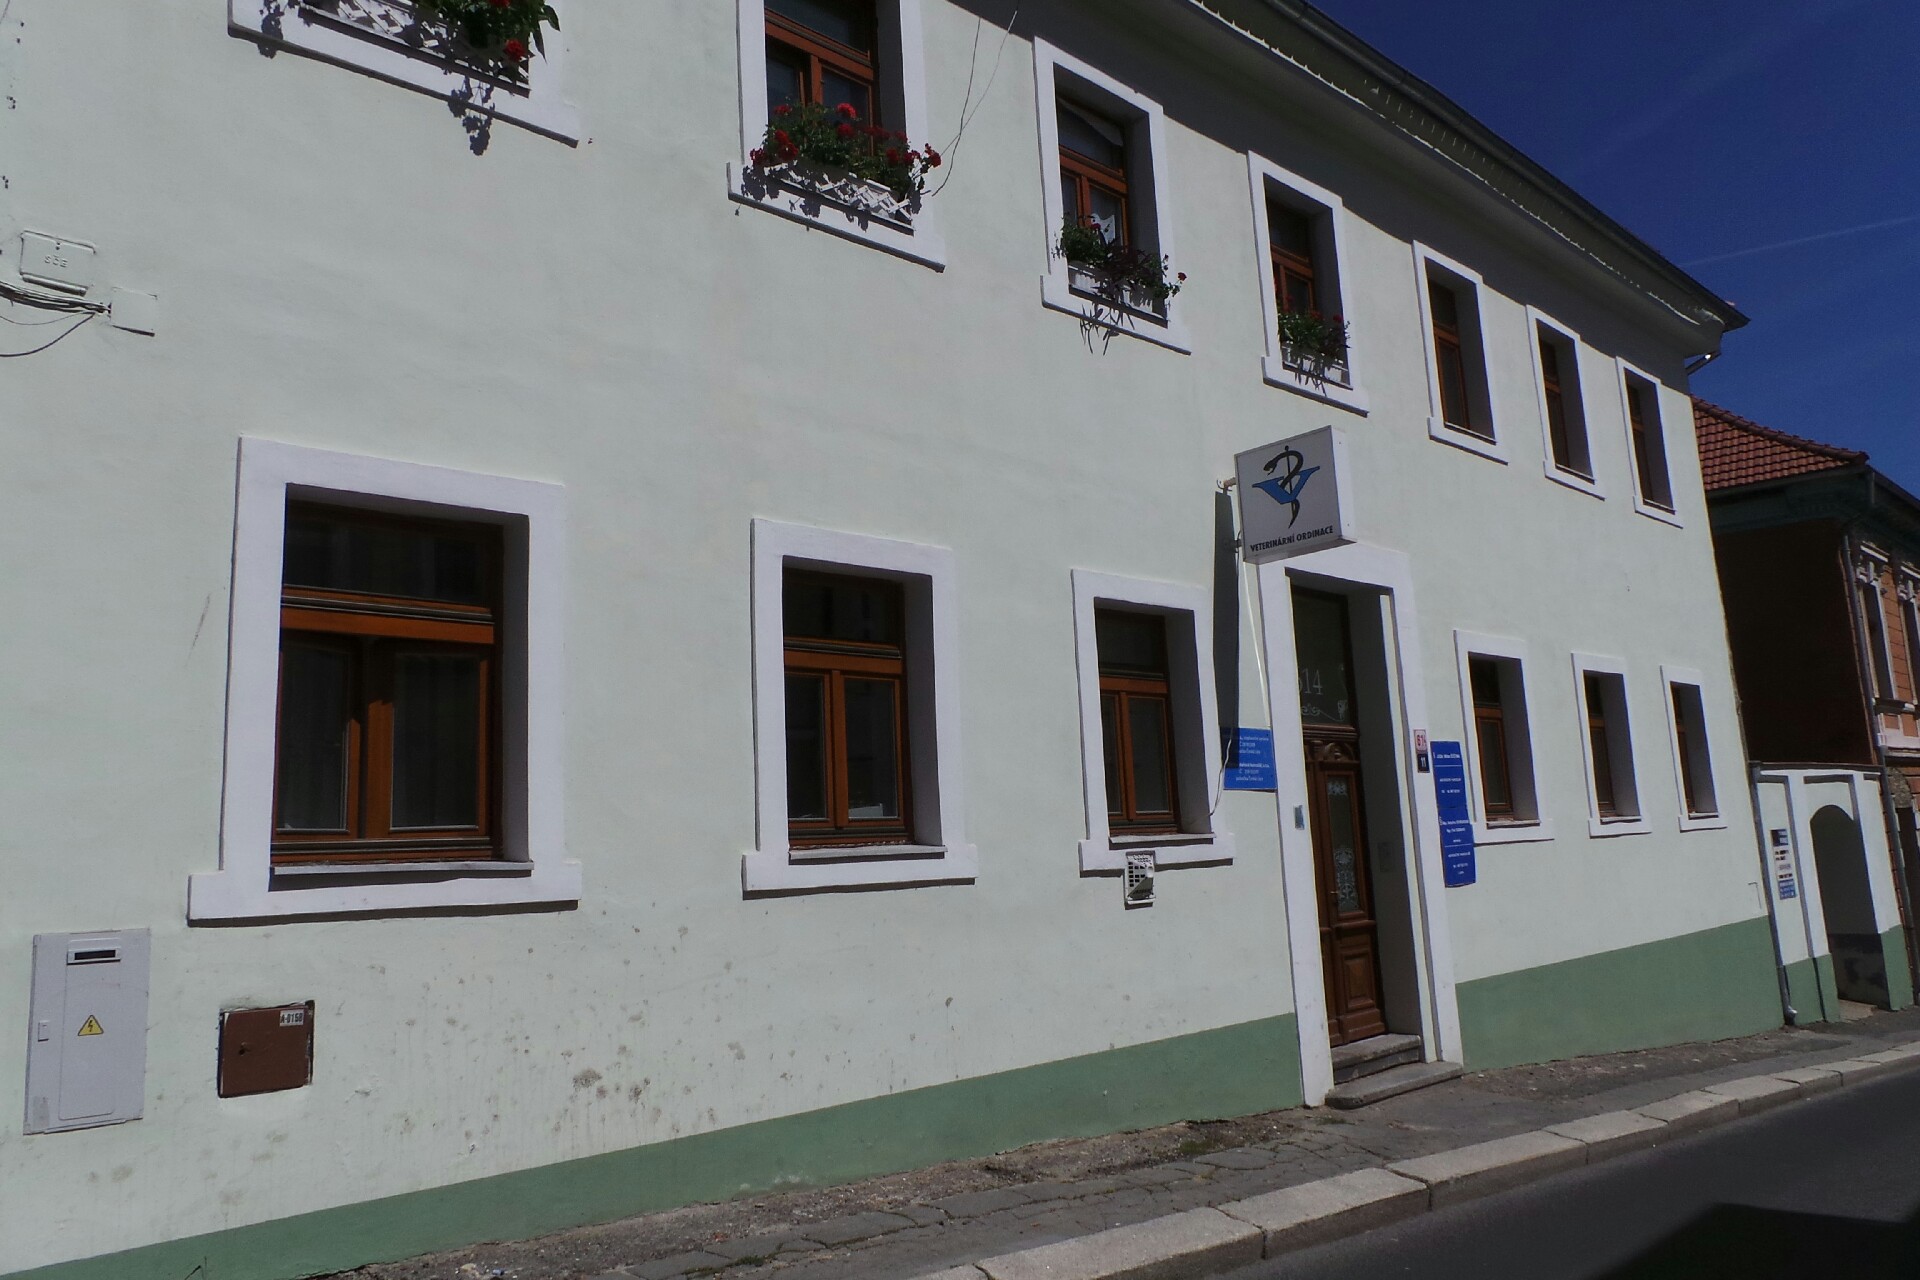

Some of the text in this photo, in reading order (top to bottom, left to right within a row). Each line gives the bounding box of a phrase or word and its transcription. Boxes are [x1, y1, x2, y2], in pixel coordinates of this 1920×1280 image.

[1250, 525, 1333, 552] VETERINÁRNÍ ORDINACE
[1299, 668, 1323, 696] 14
